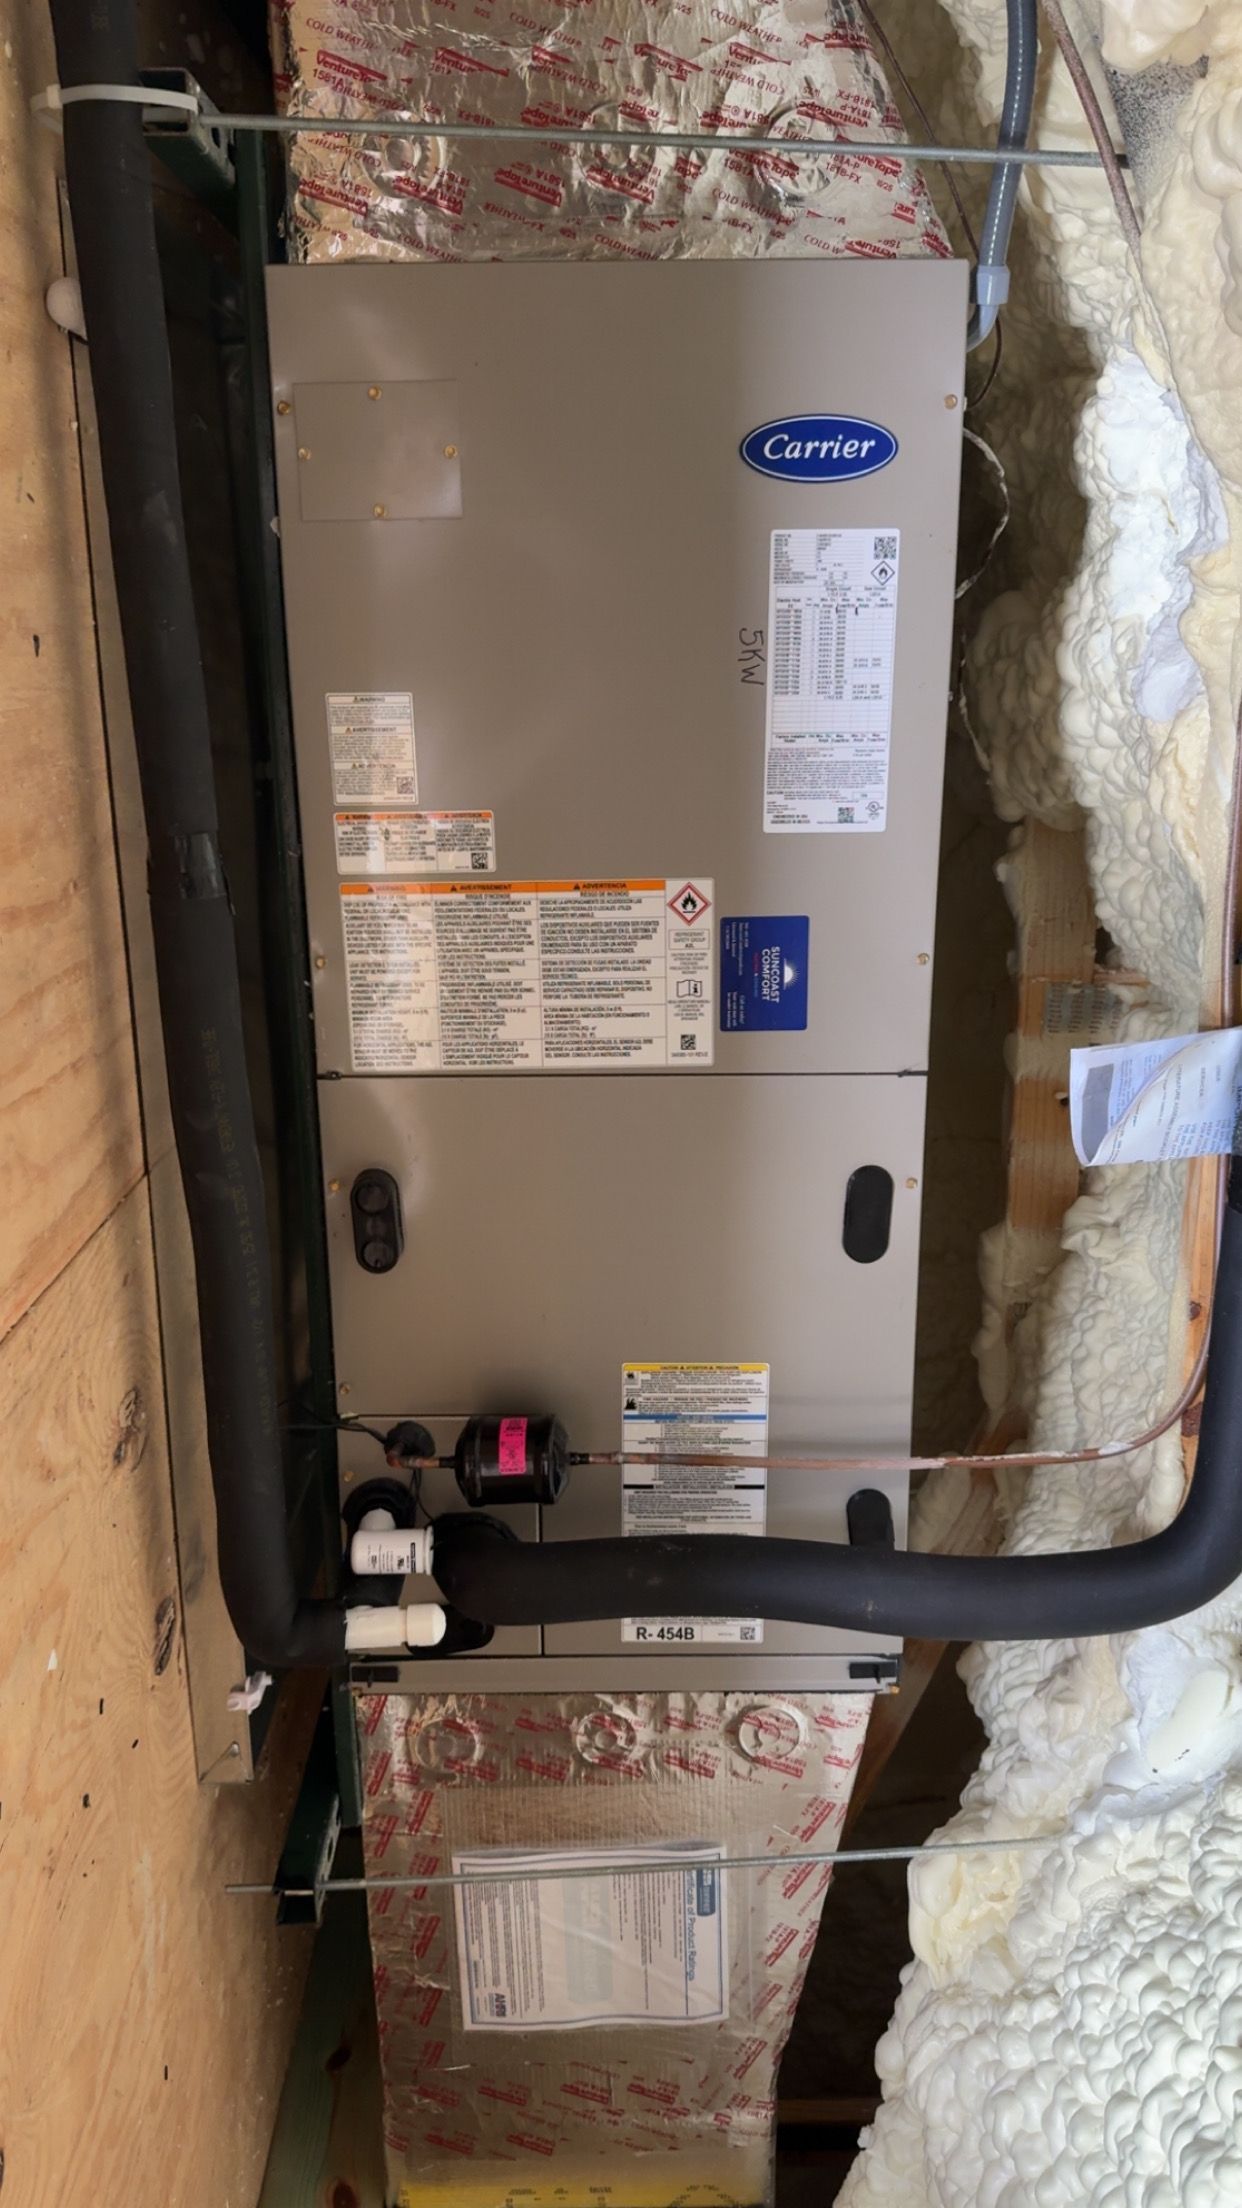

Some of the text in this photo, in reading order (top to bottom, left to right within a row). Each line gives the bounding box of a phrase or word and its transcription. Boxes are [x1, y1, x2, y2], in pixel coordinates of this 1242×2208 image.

[306, 17, 334, 34] COLD
[509, 12, 537, 30] COLD
[710, 8, 736, 27] COLD
[757, 77, 785, 96] COLD
[712, 188, 739, 205] COLD
[763, 434, 876, 460] Carrier
[738, 628, 765, 686] 5KW
[582, 882, 627, 890] ADVERTENCIA
[761, 948, 770, 1001] COMFORT
[769, 946, 781, 1003] SUNCOAST
[636, 1627, 695, 1641] R- 454B
[687, 1917, 697, 1949] Product
